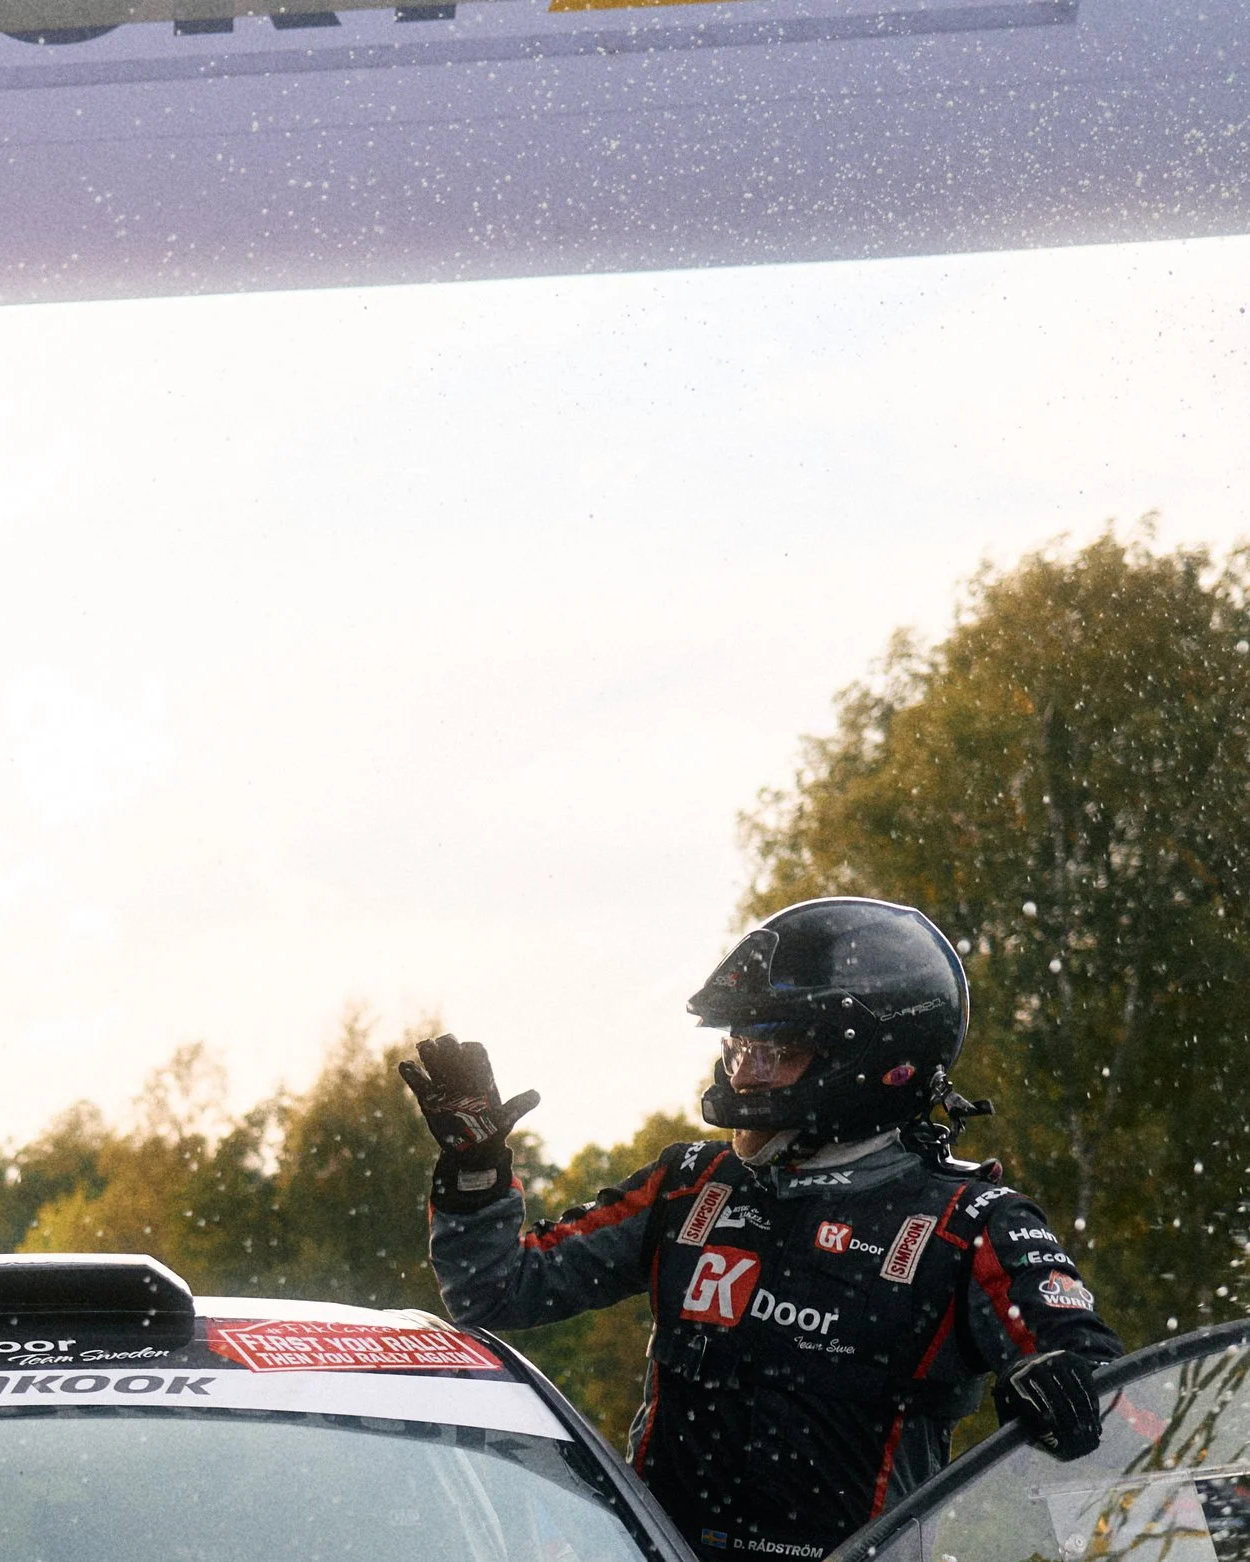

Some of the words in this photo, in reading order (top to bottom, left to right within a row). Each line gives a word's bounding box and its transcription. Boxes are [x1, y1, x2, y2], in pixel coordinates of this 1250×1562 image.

[789, 1170, 854, 1188] HRX
[686, 1190, 721, 1240] SIMPSON
[819, 1225, 850, 1251] GK
[850, 1239, 884, 1255] Door
[891, 1220, 925, 1275] SIMPSON
[682, 1252, 757, 1319] GK
[751, 1288, 839, 1335] Door
[237, 1333, 326, 1353] FIRST
[325, 1336, 382, 1353] YOU
[384, 1333, 455, 1352] RALLY
[794, 1336, 823, 1351] Team
[7, 1353, 75, 1366] Team
[81, 1346, 171, 1363] Sweden
[256, 1353, 314, 1365] THEN
[314, 1353, 360, 1365] YOU
[360, 1353, 417, 1364] RALLY
[415, 1352, 477, 1364] AGAIN
[733, 1538, 745, 1550] D.
[748, 1538, 824, 1559] RÅDSTRÖM
